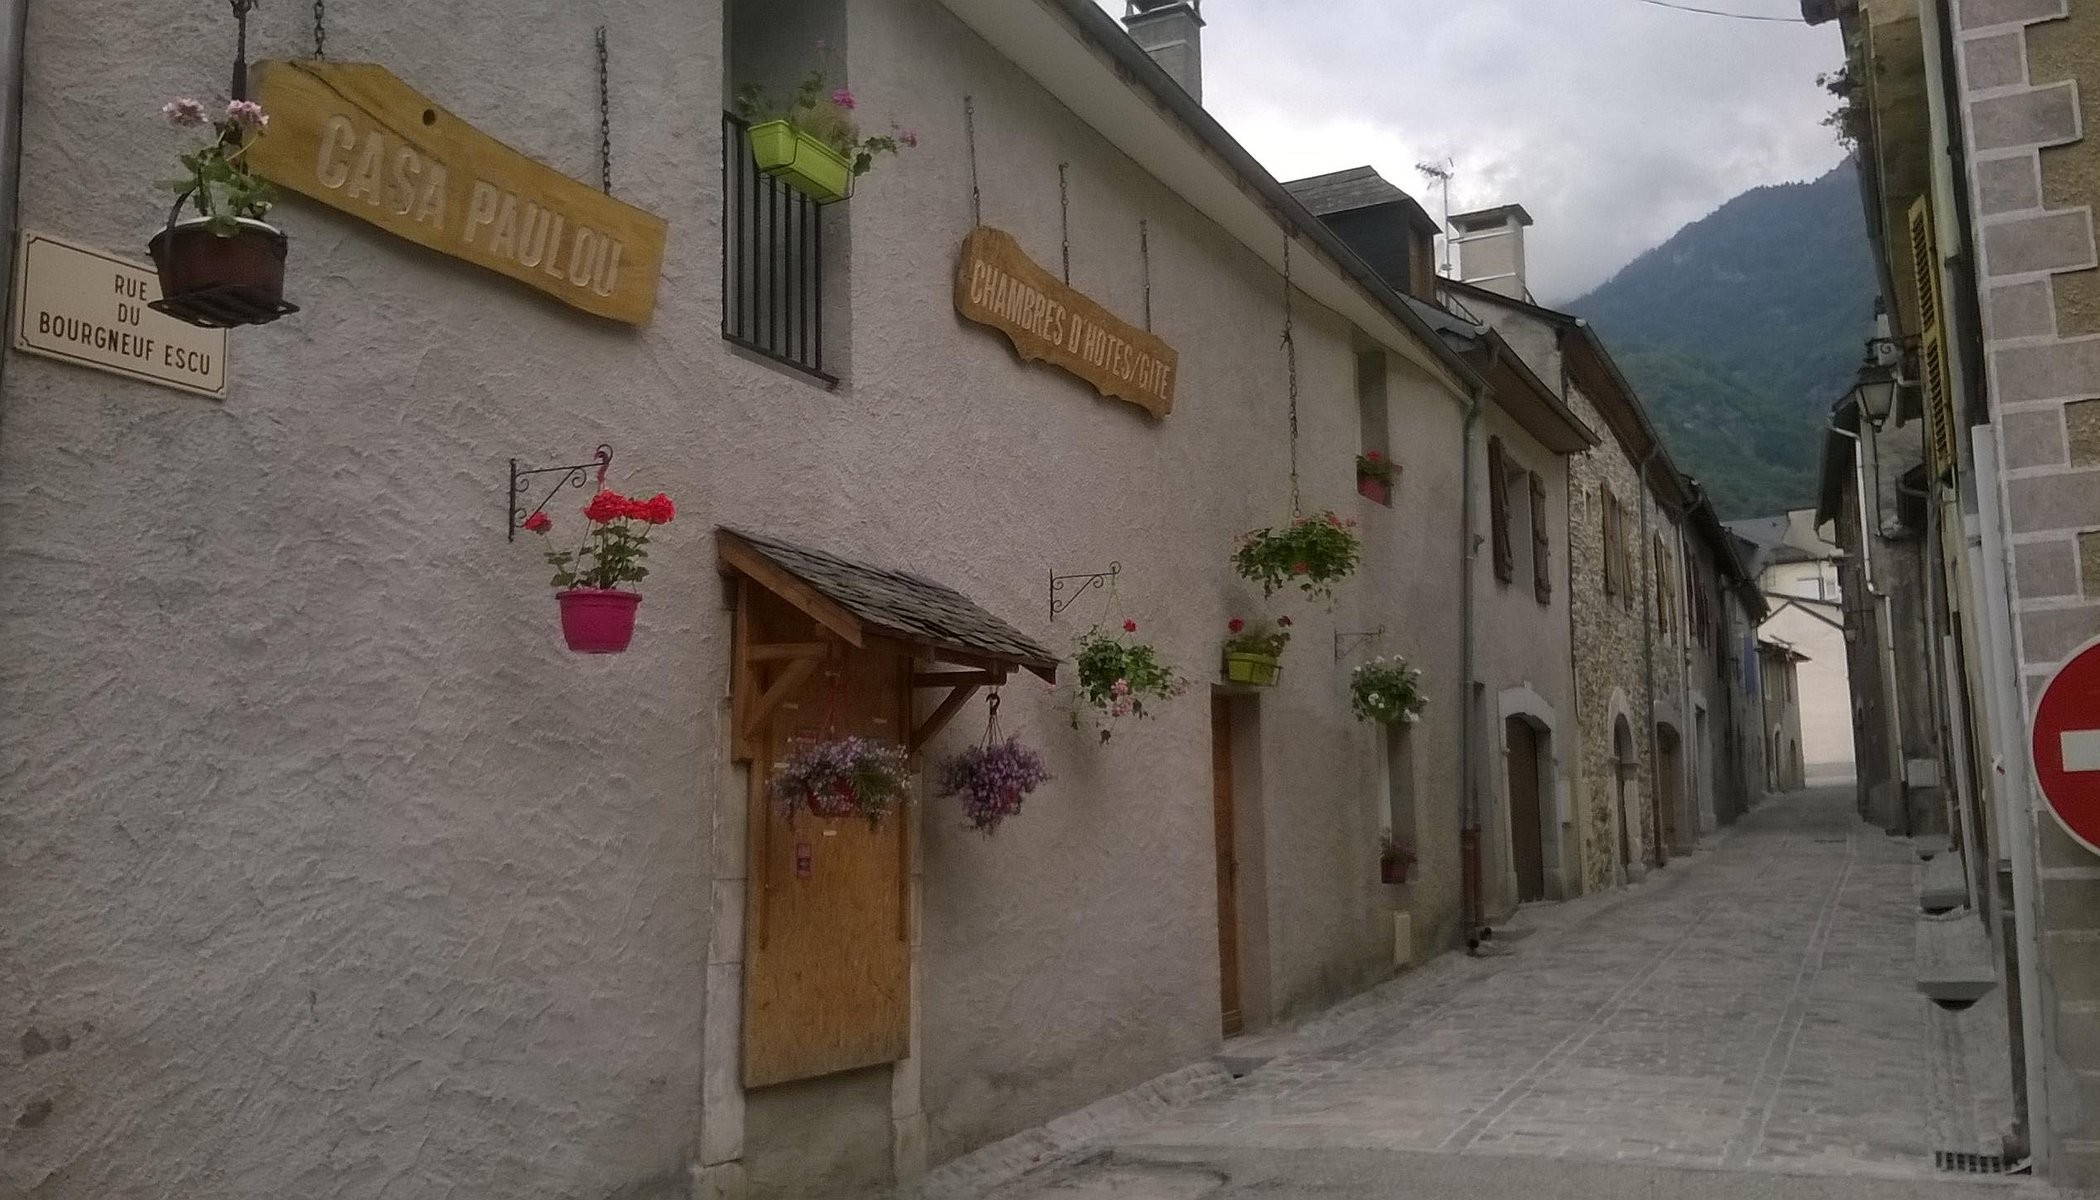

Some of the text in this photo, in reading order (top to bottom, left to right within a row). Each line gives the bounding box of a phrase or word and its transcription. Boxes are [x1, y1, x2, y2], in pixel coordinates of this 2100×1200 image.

[316, 115, 622, 298] CASA PAULOU
[114, 274, 148, 301] RUE
[117, 303, 140, 326] DU
[970, 260, 1067, 345] CHAMBRES
[39, 311, 210, 375] BOURGNEUF ESCU
